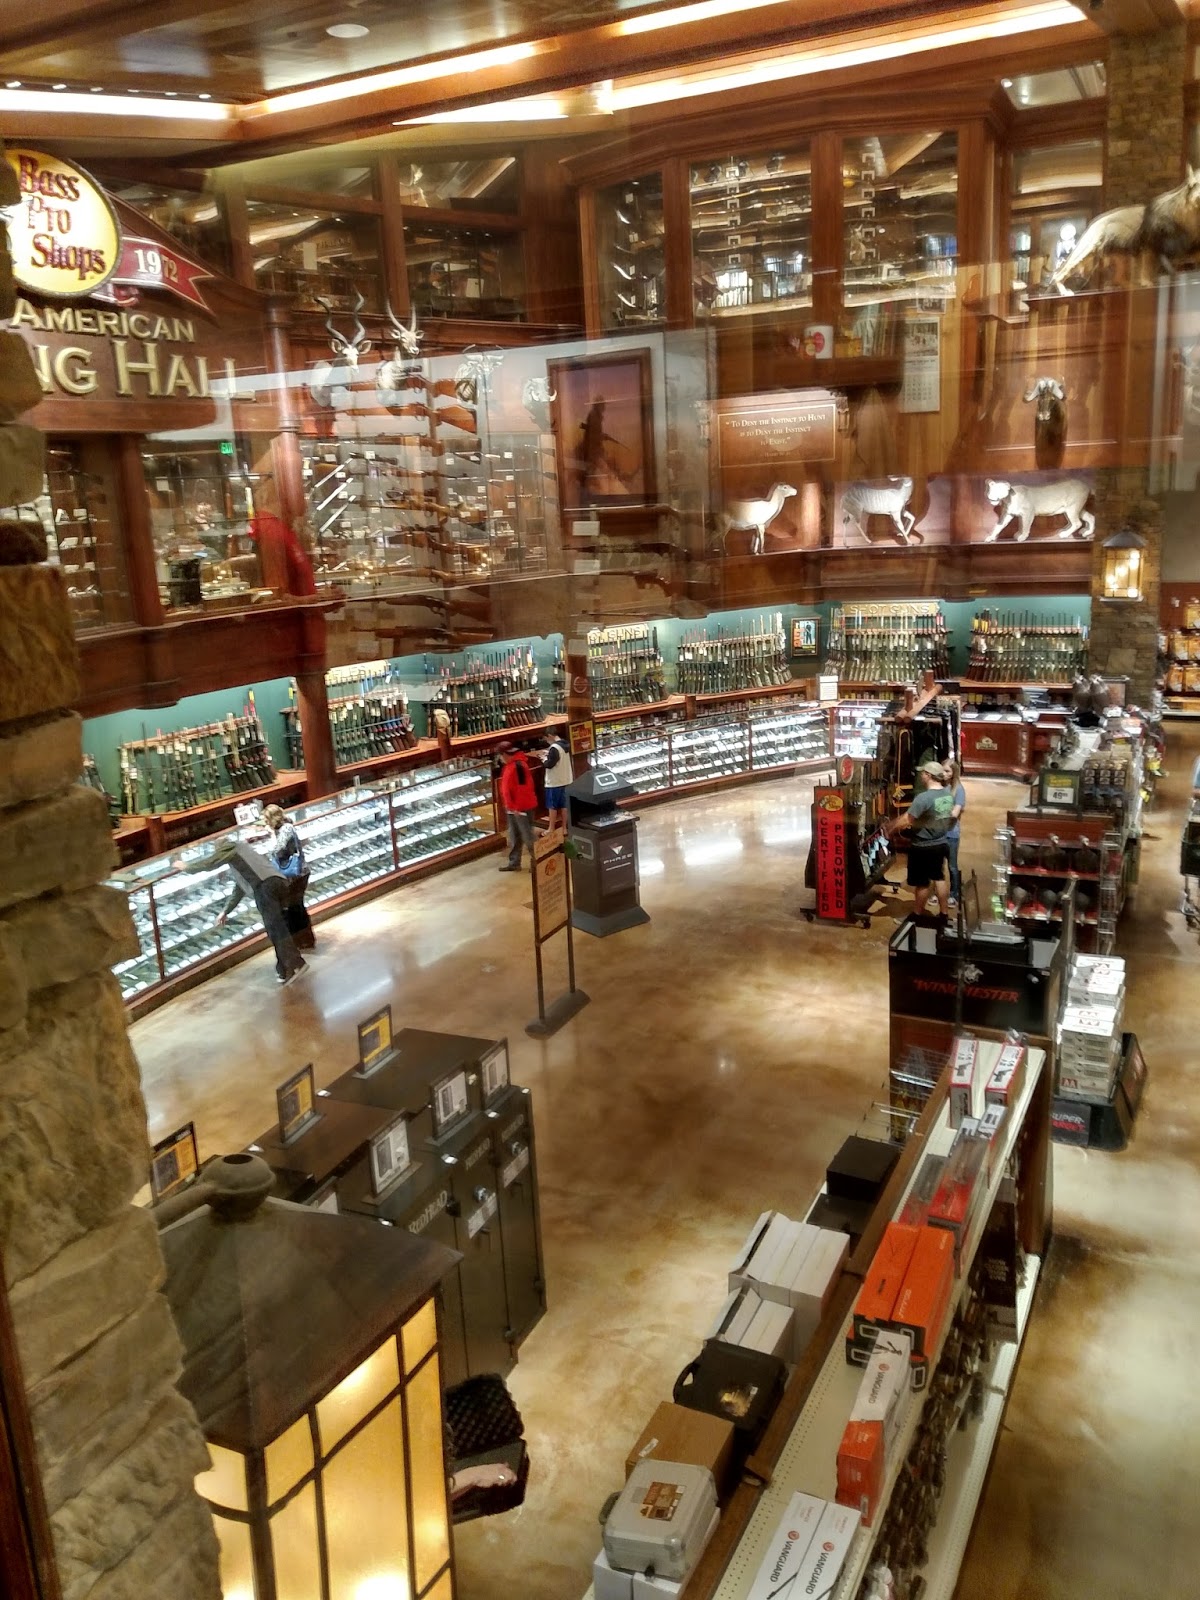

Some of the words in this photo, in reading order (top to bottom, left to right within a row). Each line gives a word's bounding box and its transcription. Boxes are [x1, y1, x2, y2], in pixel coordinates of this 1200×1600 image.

[18, 154, 81, 201] Bass
[31, 233, 106, 281] Shops
[135, 249, 179, 284] 1972
[11, 300, 195, 343] AMERICAN
[112, 340, 257, 402] HALL
[741, 419, 758, 427] DENY
[770, 417, 797, 425] INSTINCT
[807, 413, 826, 421] HUNT
[755, 428, 771, 436] DENY
[785, 426, 812, 434] INSTINCT
[820, 816, 829, 913] CERTIFIED
[833, 823, 845, 909] PREOWNED
[868, 1371, 886, 1404] VANGUARD
[769, 1540, 794, 1583] VANGUARD
[805, 1552, 829, 1595] VANGUARD
